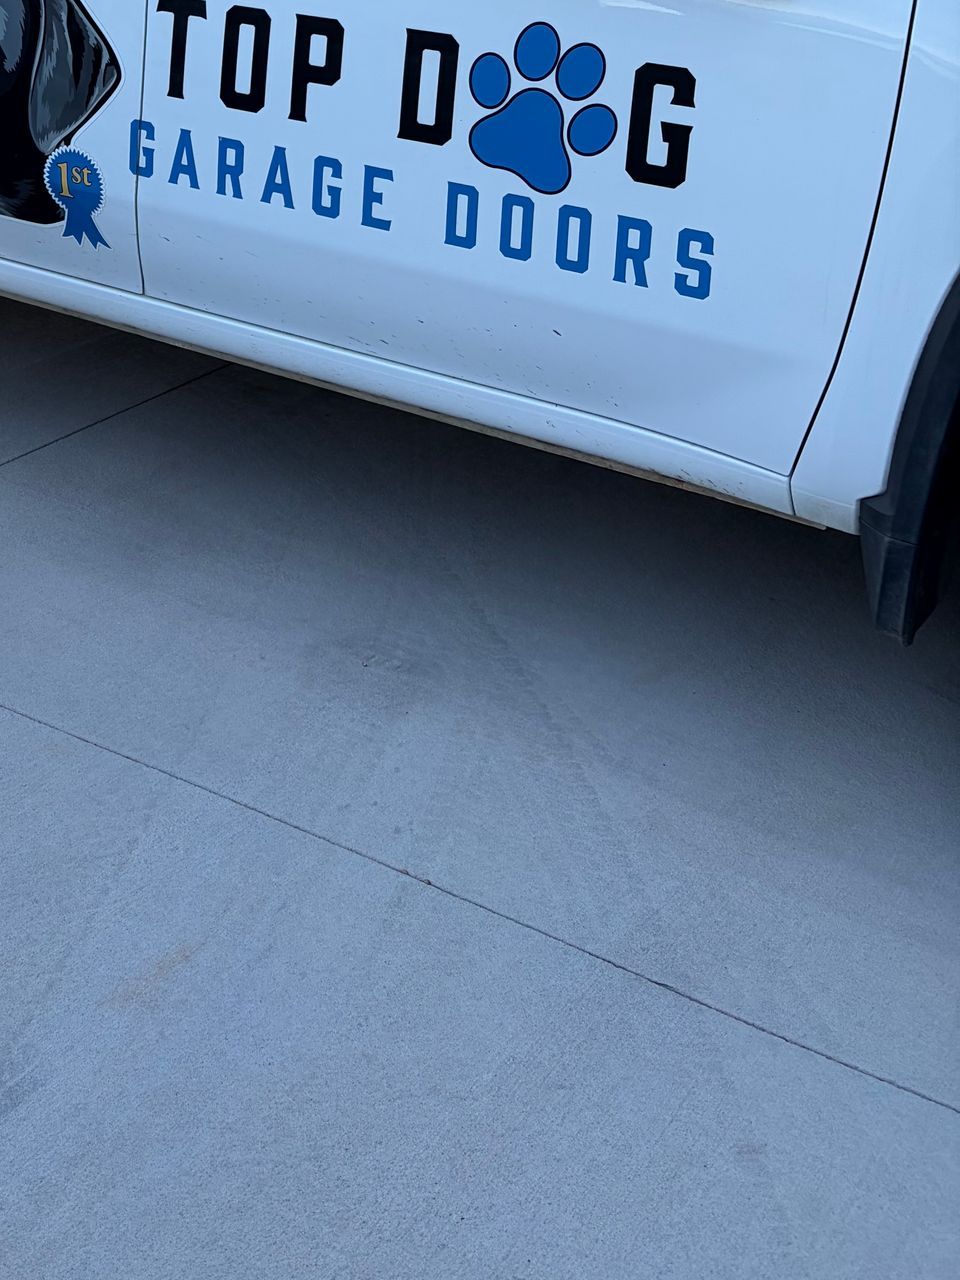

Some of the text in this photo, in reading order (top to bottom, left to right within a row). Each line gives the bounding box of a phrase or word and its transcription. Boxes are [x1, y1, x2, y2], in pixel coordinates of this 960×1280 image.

[58, 162, 92, 198] 1st
[129, 119, 715, 300] GARAGE DOORS
